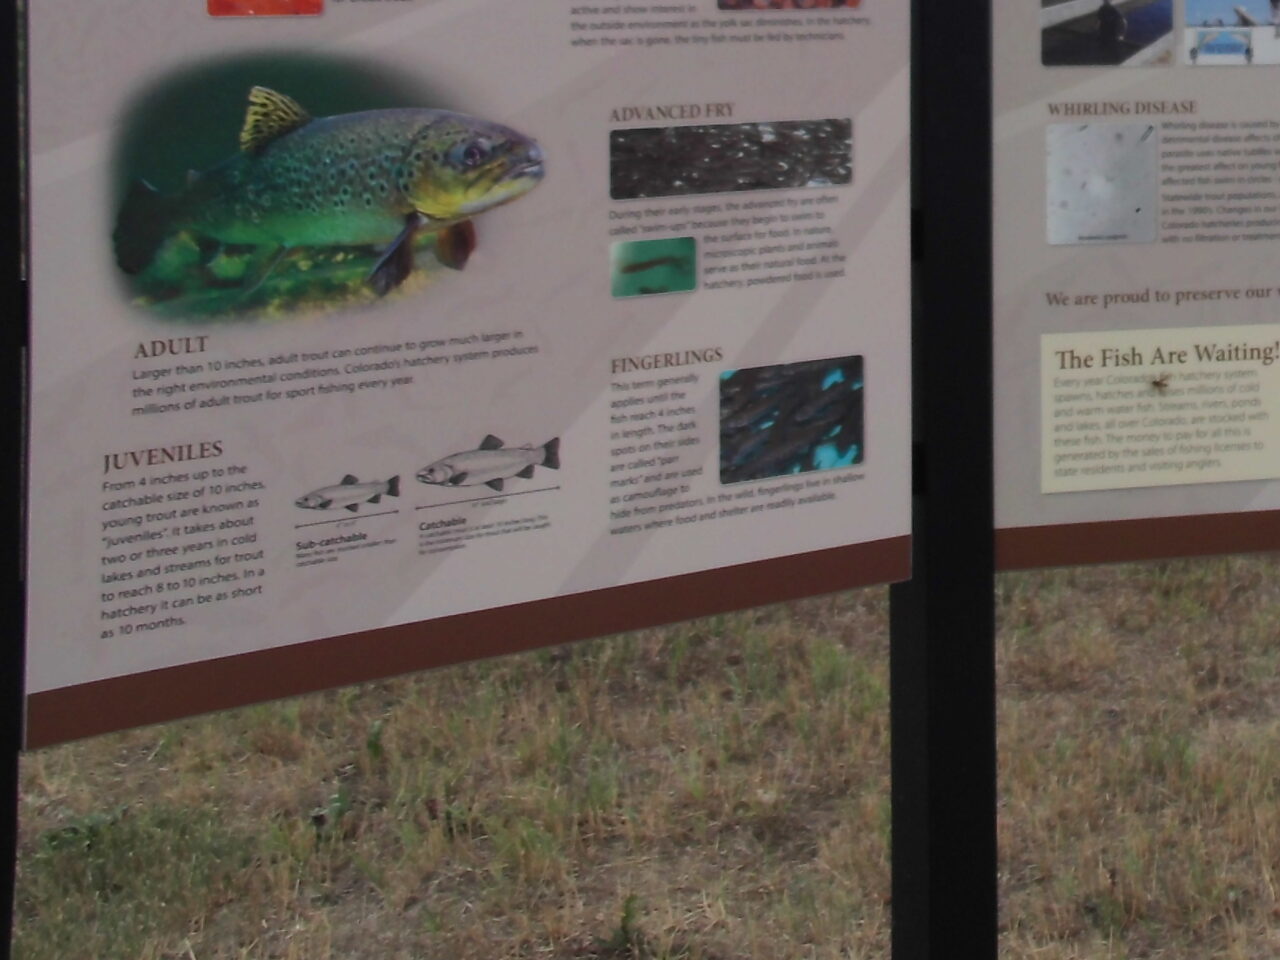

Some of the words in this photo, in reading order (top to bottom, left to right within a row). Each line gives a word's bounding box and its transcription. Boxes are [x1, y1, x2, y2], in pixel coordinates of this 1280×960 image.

[610, 104, 701, 122] ADVANCED
[705, 103, 735, 118] FRY
[1048, 101, 1131, 115] WHIRLING
[1134, 100, 1197, 114] DISEASE
[1045, 291, 1070, 306] We
[1073, 294, 1098, 305] are
[1102, 287, 1150, 309] proud
[1154, 288, 1171, 302] to
[1174, 288, 1241, 306] preserve
[1244, 287, 1272, 298] our
[134, 336, 209, 359] ADULT
[1056, 349, 1093, 369] The
[1100, 347, 1143, 367] Fish
[1151, 346, 1187, 365] Are
[1194, 341, 1280, 367] Waiting!
[611, 348, 722, 374] FINGERLINGS
[104, 440, 223, 473] JUVENILES
